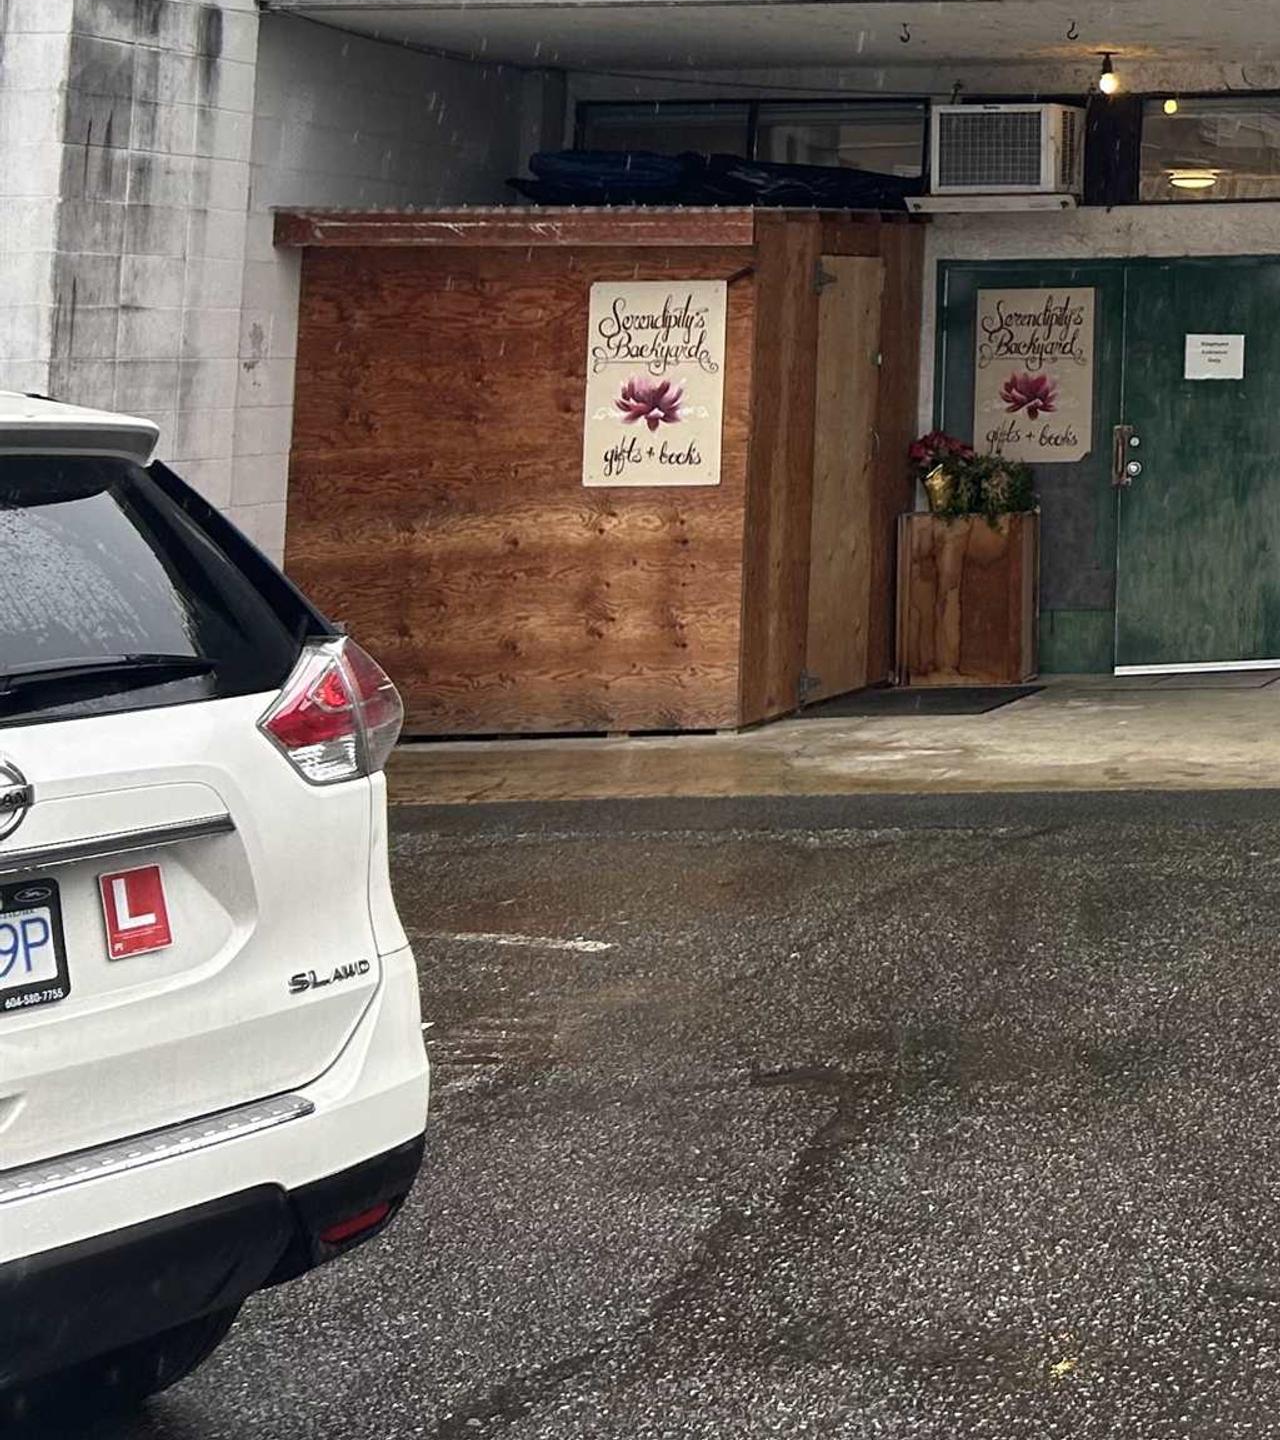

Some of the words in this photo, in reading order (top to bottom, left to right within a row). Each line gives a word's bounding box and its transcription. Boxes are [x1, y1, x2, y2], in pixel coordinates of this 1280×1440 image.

[599, 294, 709, 343] Serendipity's
[981, 295, 1084, 340] Serendipity's
[604, 331, 714, 375] Backyard
[985, 328, 1084, 371] Backyard
[603, 436, 643, 476] gifts
[659, 438, 702, 465] books
[1038, 423, 1079, 447] books
[111, 878, 157, 931] L
[288, 970, 330, 995] SL
[333, 960, 370, 981] AWD
